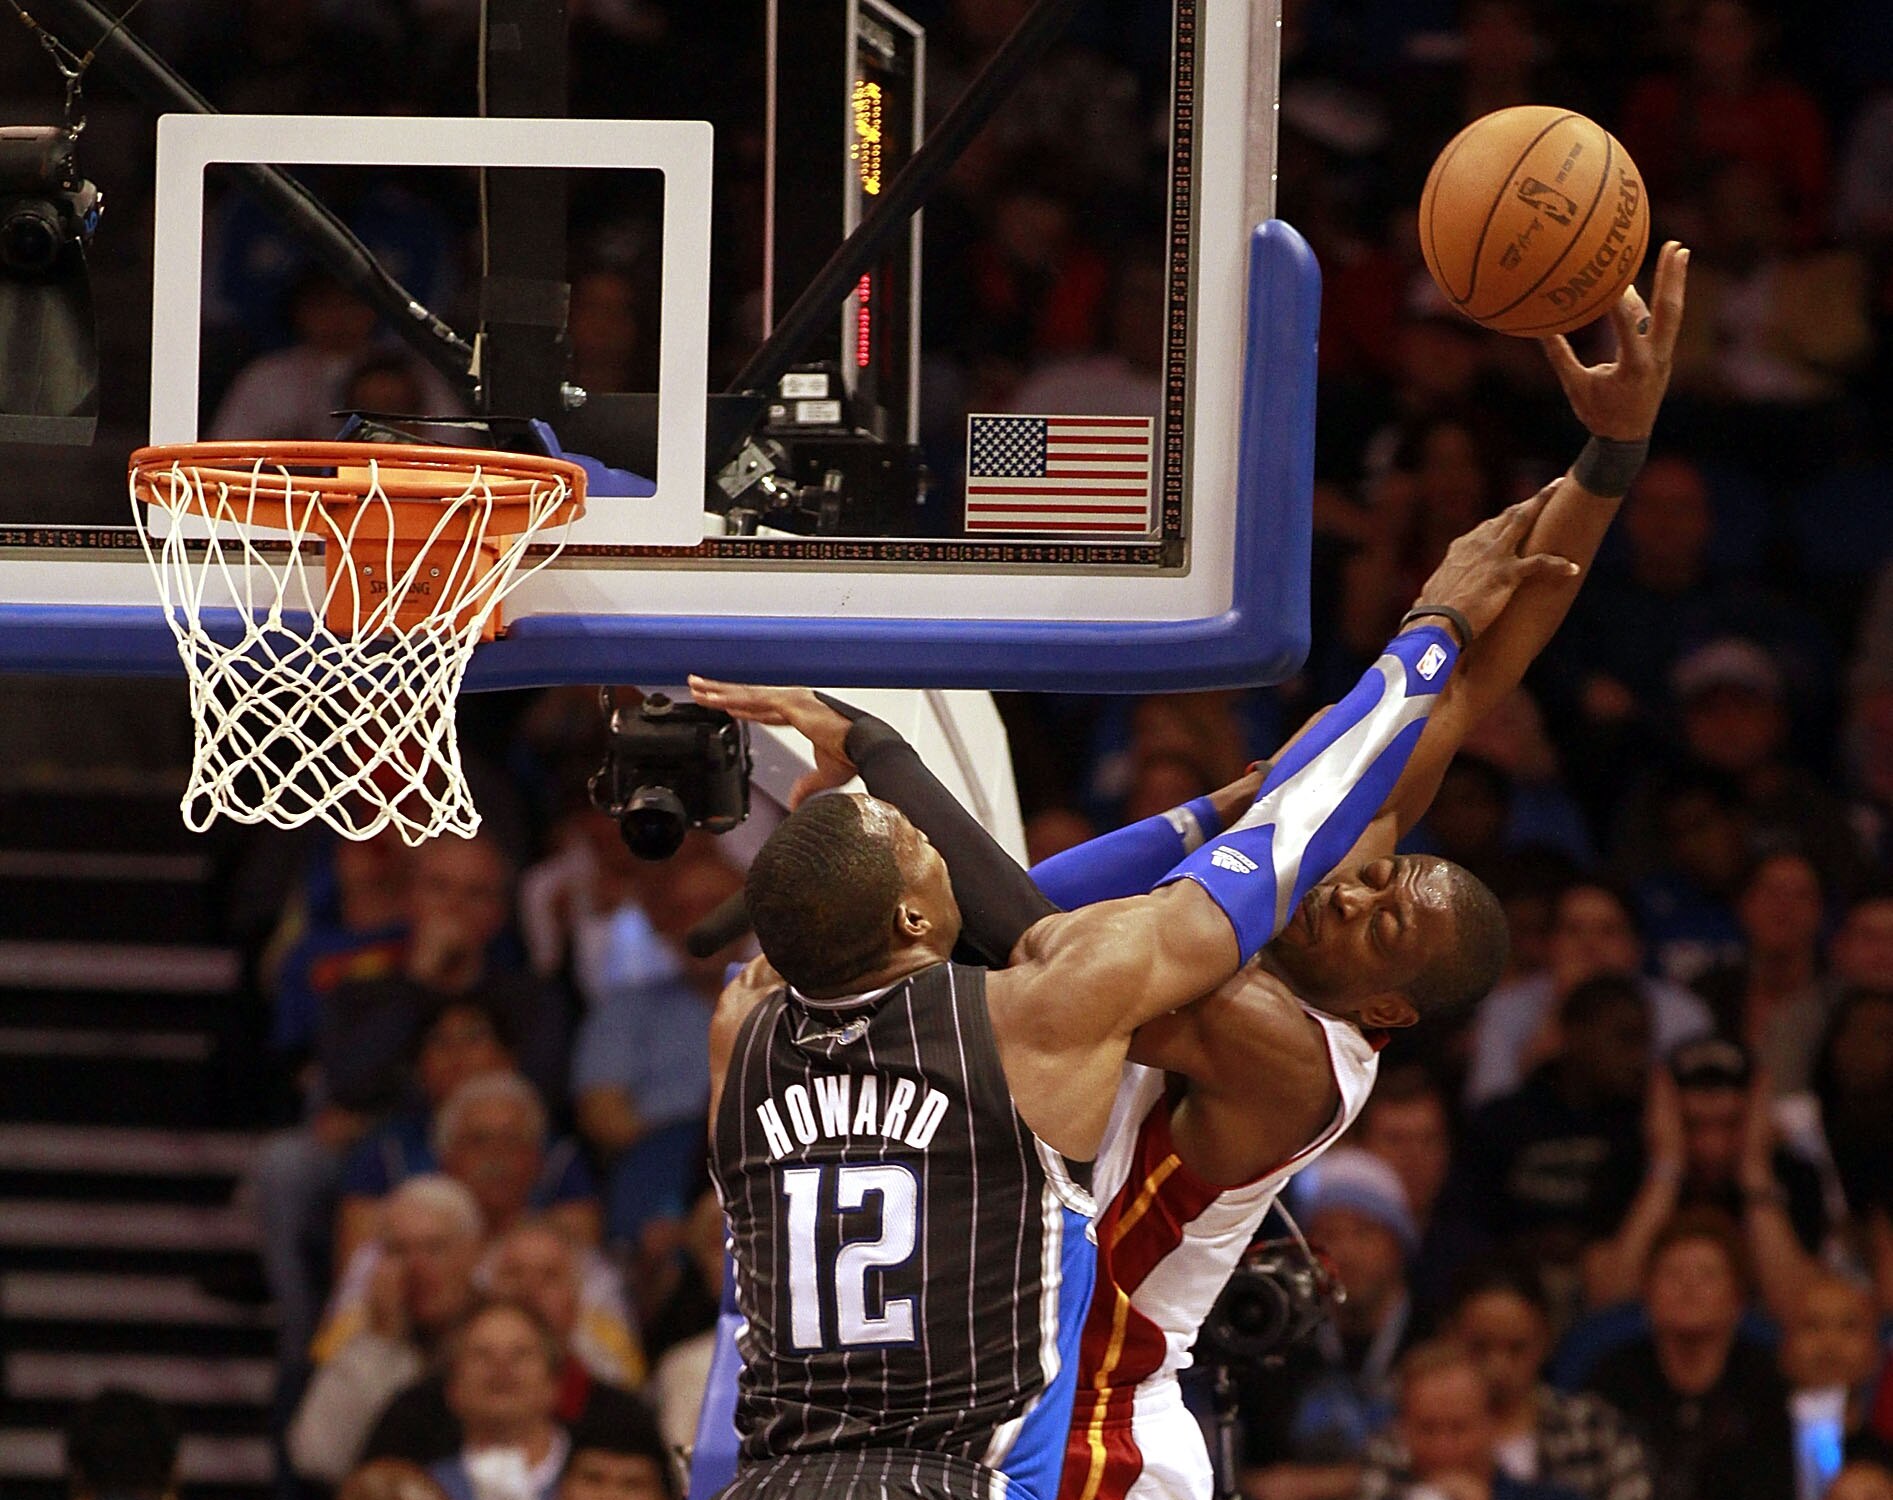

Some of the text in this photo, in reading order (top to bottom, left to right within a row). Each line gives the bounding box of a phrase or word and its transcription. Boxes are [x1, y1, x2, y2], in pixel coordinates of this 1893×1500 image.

[1546, 167, 1640, 309] SPALDING
[756, 1074, 949, 1160] HOWARD
[782, 1164, 919, 1350] 12
